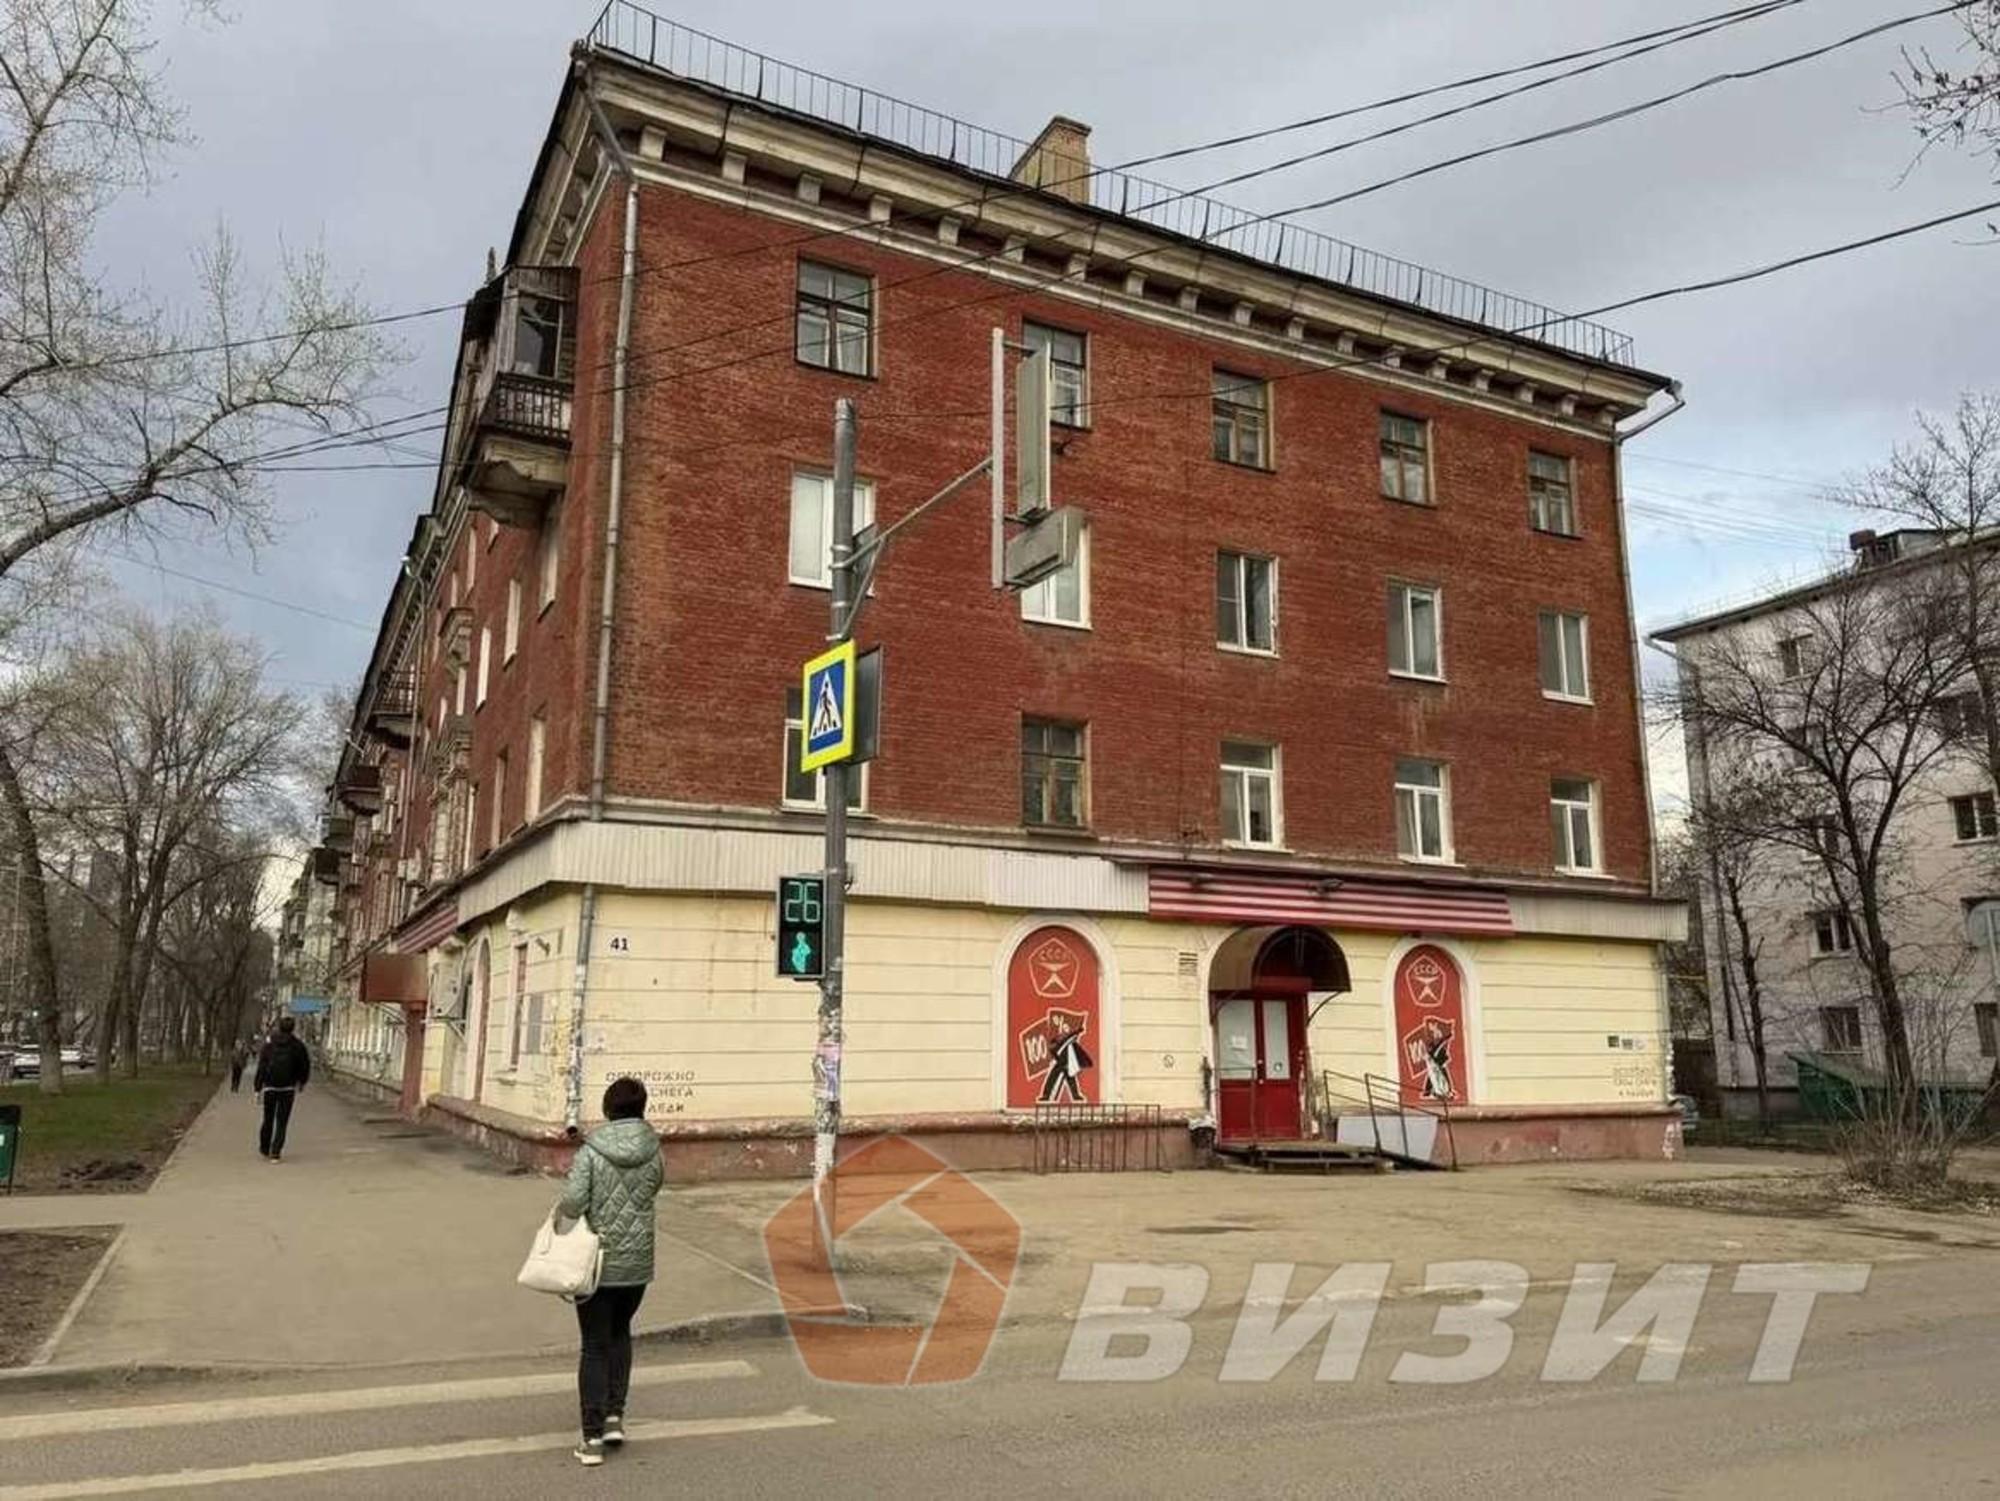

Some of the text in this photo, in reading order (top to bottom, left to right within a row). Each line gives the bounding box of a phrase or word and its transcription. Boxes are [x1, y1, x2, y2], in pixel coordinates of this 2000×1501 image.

[785, 881, 820, 922] 26
[610, 937, 628, 950] 41
[1025, 1034, 1047, 1065] 100
[650, 1086, 693, 1098] СНЕГА
